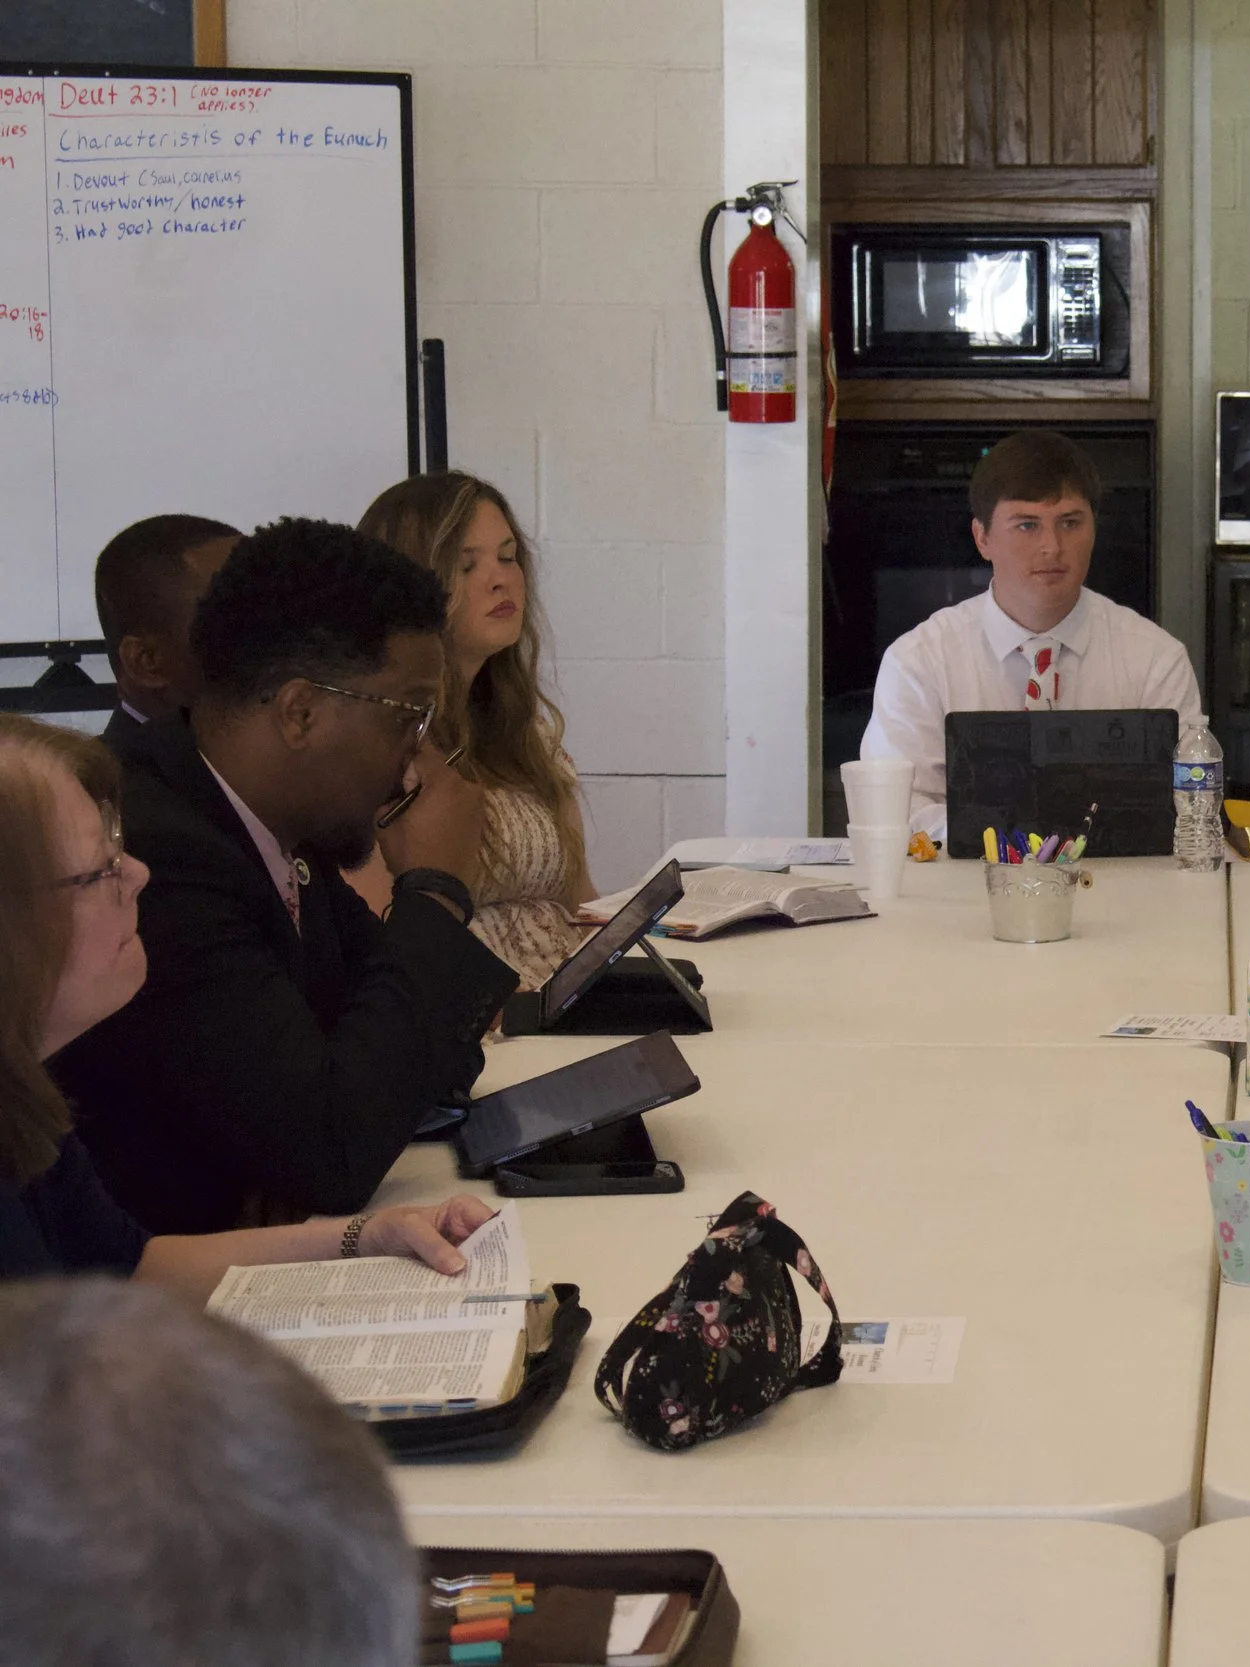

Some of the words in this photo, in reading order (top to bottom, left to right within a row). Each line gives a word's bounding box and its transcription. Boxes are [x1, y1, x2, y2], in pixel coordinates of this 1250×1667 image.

[60, 82, 118, 110] Deut
[129, 84, 177, 107] 23:1
[225, 86, 272, 99] longer
[234, 129, 262, 147] of
[275, 127, 314, 147] the
[324, 126, 388, 149] Eunuch
[73, 171, 131, 191] Devout
[75, 222, 108, 241] Had
[117, 220, 153, 240] good
[29, 322, 44, 341] 18
